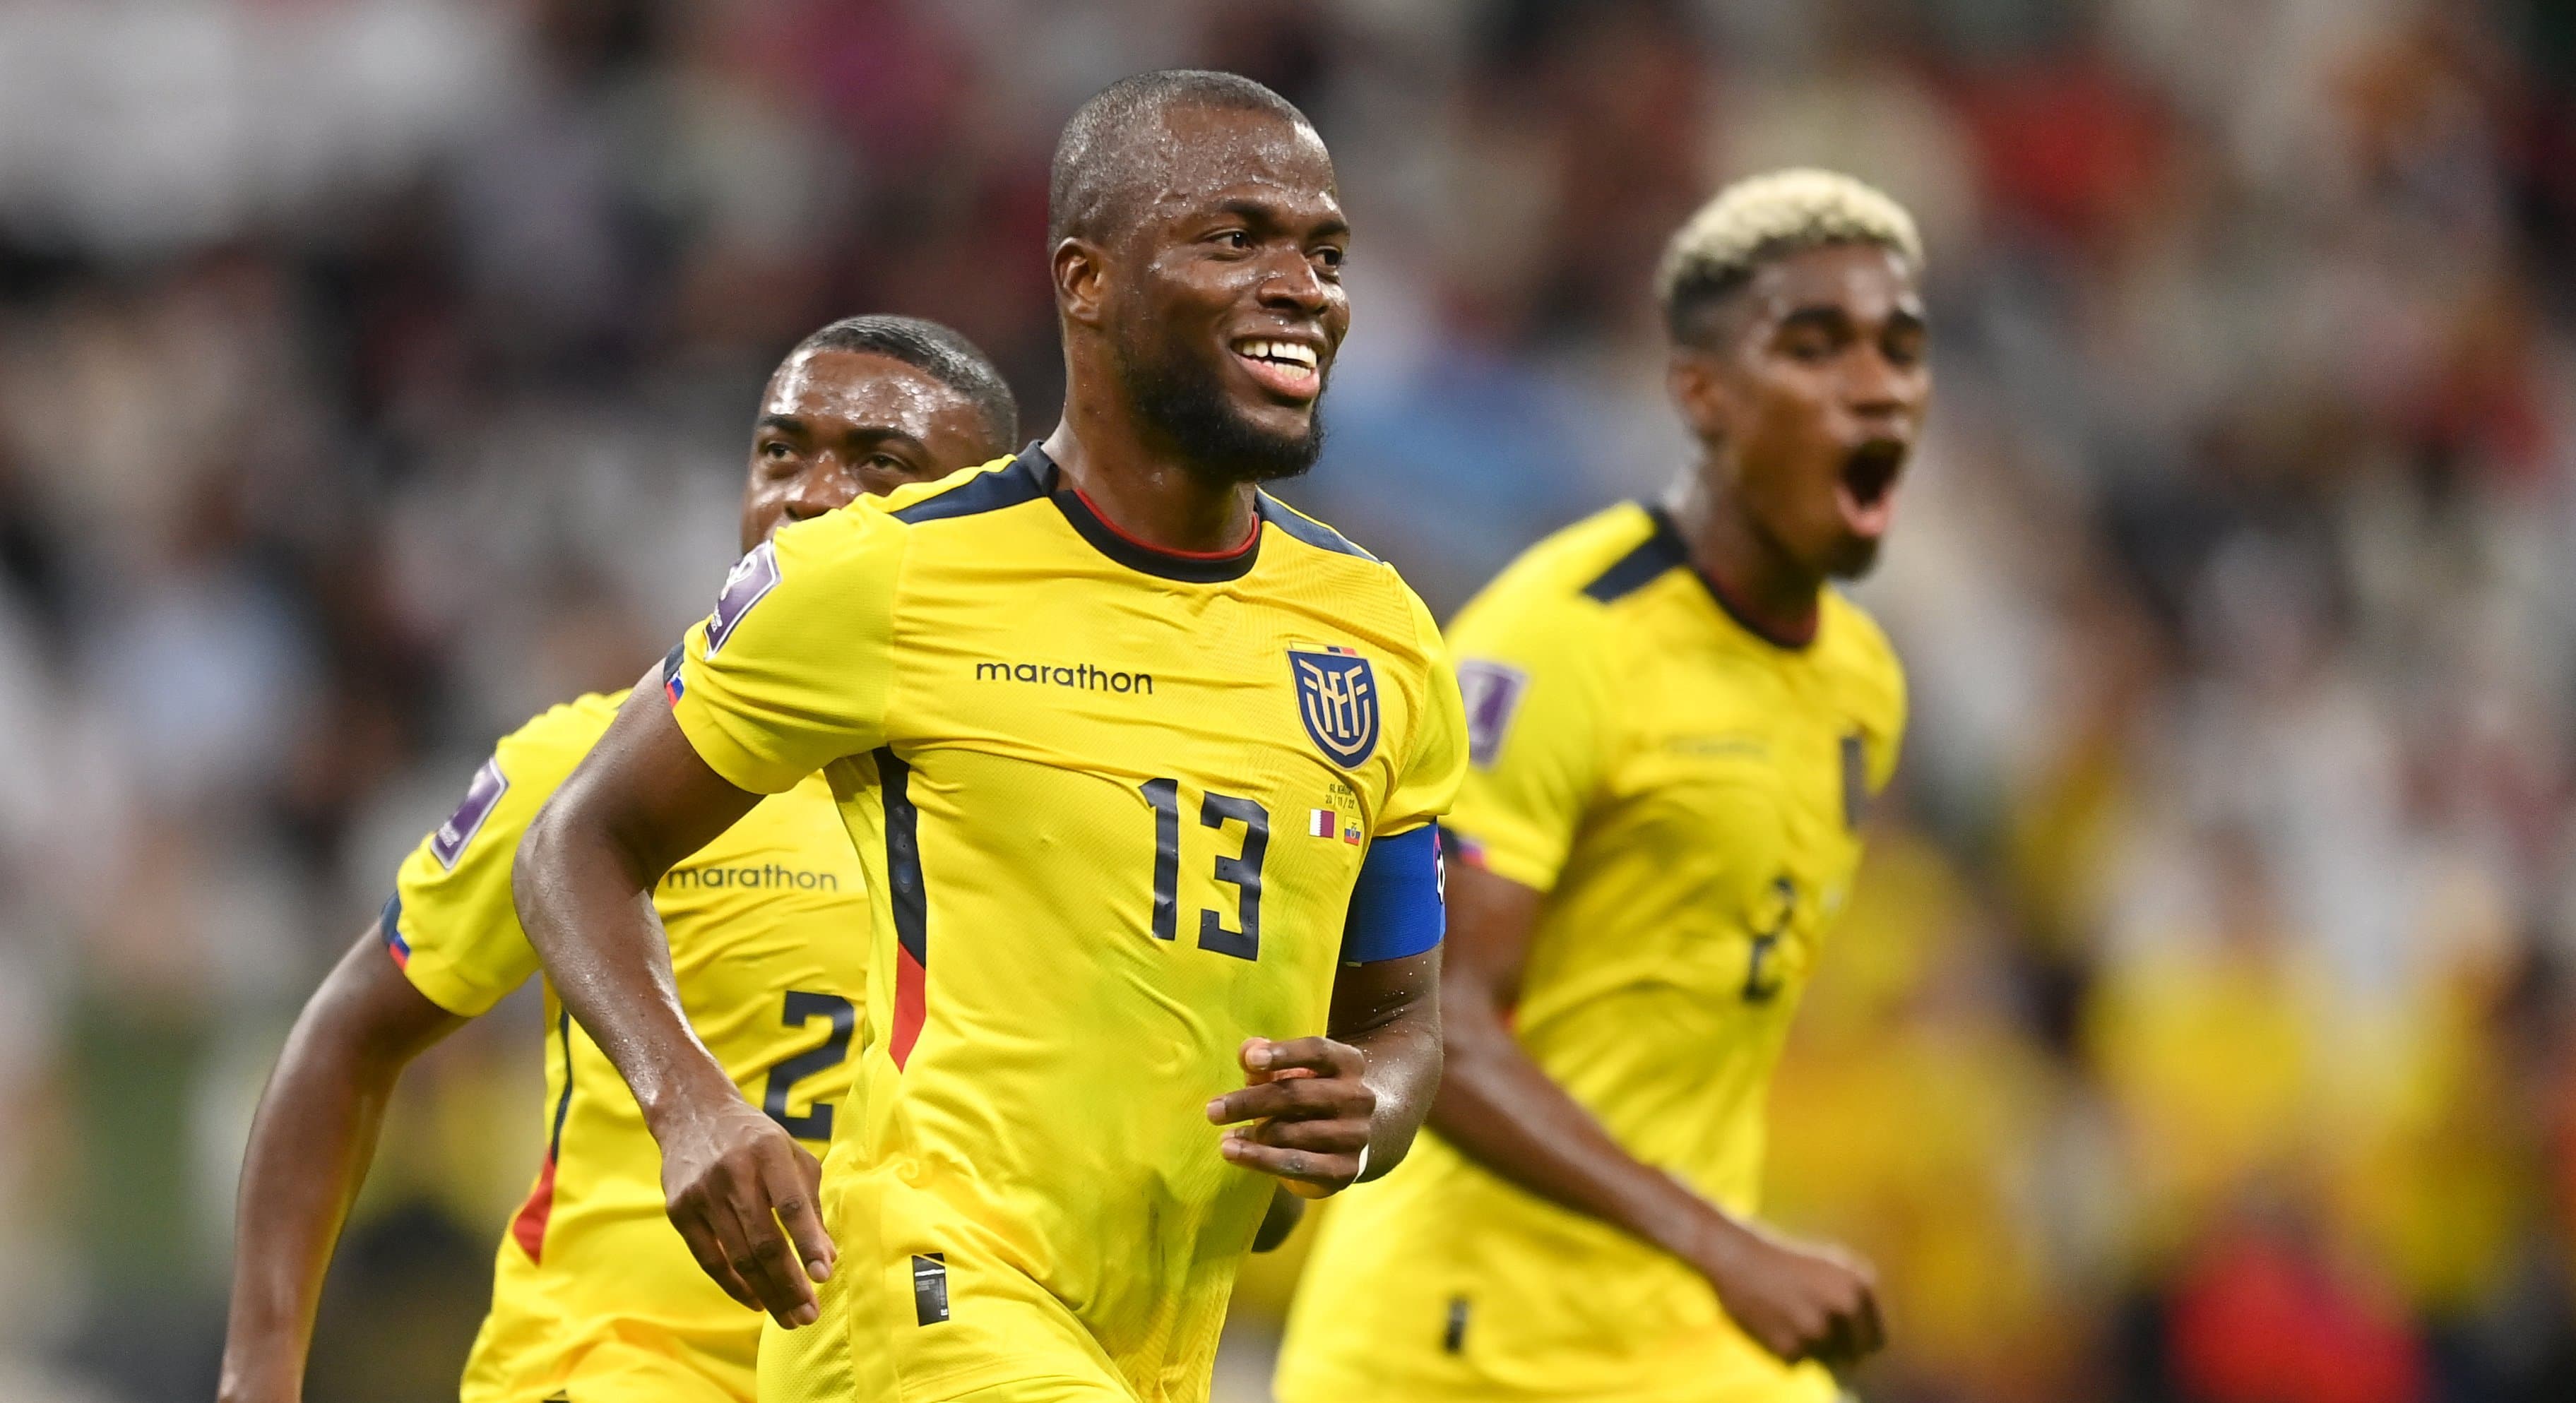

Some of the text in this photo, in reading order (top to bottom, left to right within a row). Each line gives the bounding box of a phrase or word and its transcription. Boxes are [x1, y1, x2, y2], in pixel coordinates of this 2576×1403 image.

[976, 662, 1153, 695] marathon
[668, 864, 838, 891] marathon
[1138, 777, 1269, 962] 13
[763, 990, 856, 1141] 2
